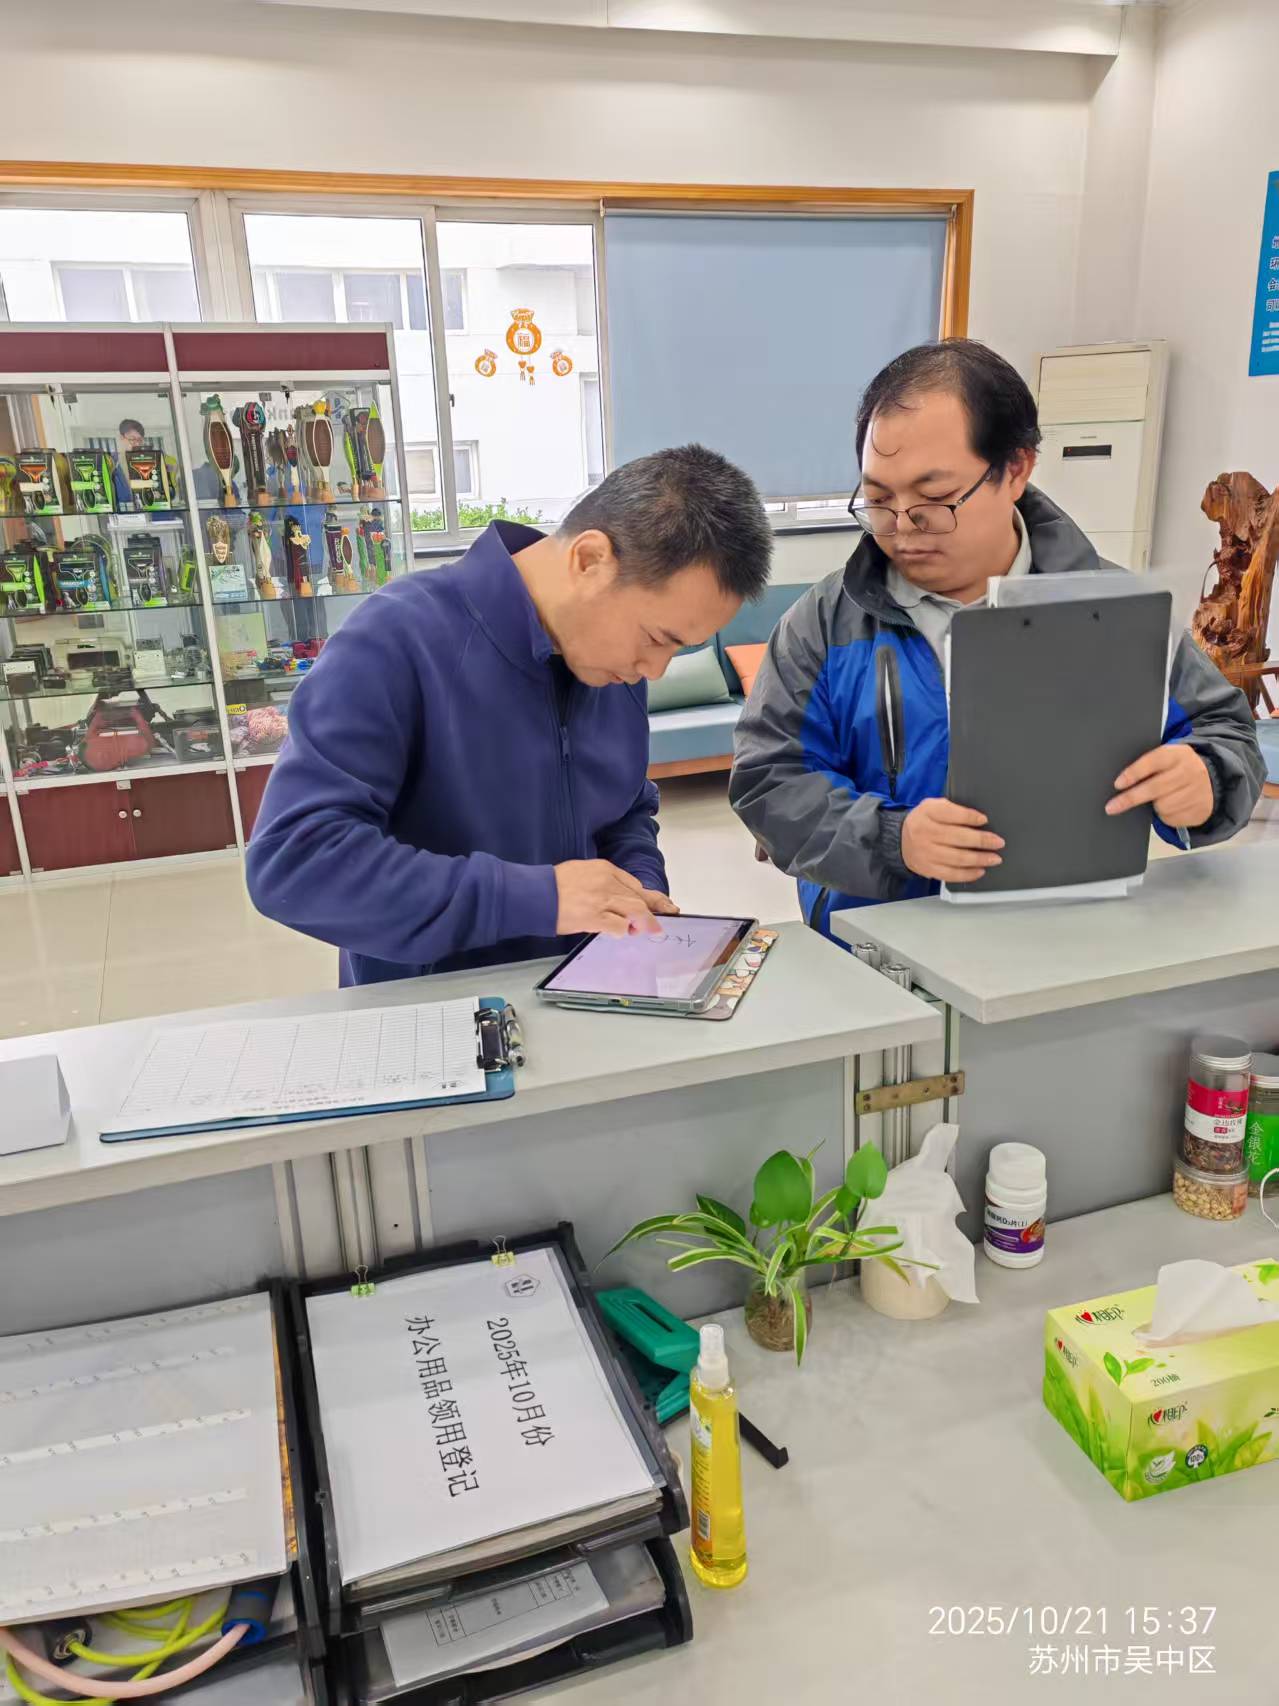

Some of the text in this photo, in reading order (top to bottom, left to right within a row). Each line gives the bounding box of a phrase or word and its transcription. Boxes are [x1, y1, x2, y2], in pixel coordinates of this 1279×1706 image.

[404, 1315, 480, 1498] 办公用品领用登记
[486, 1317, 555, 1446] 2025年10月份
